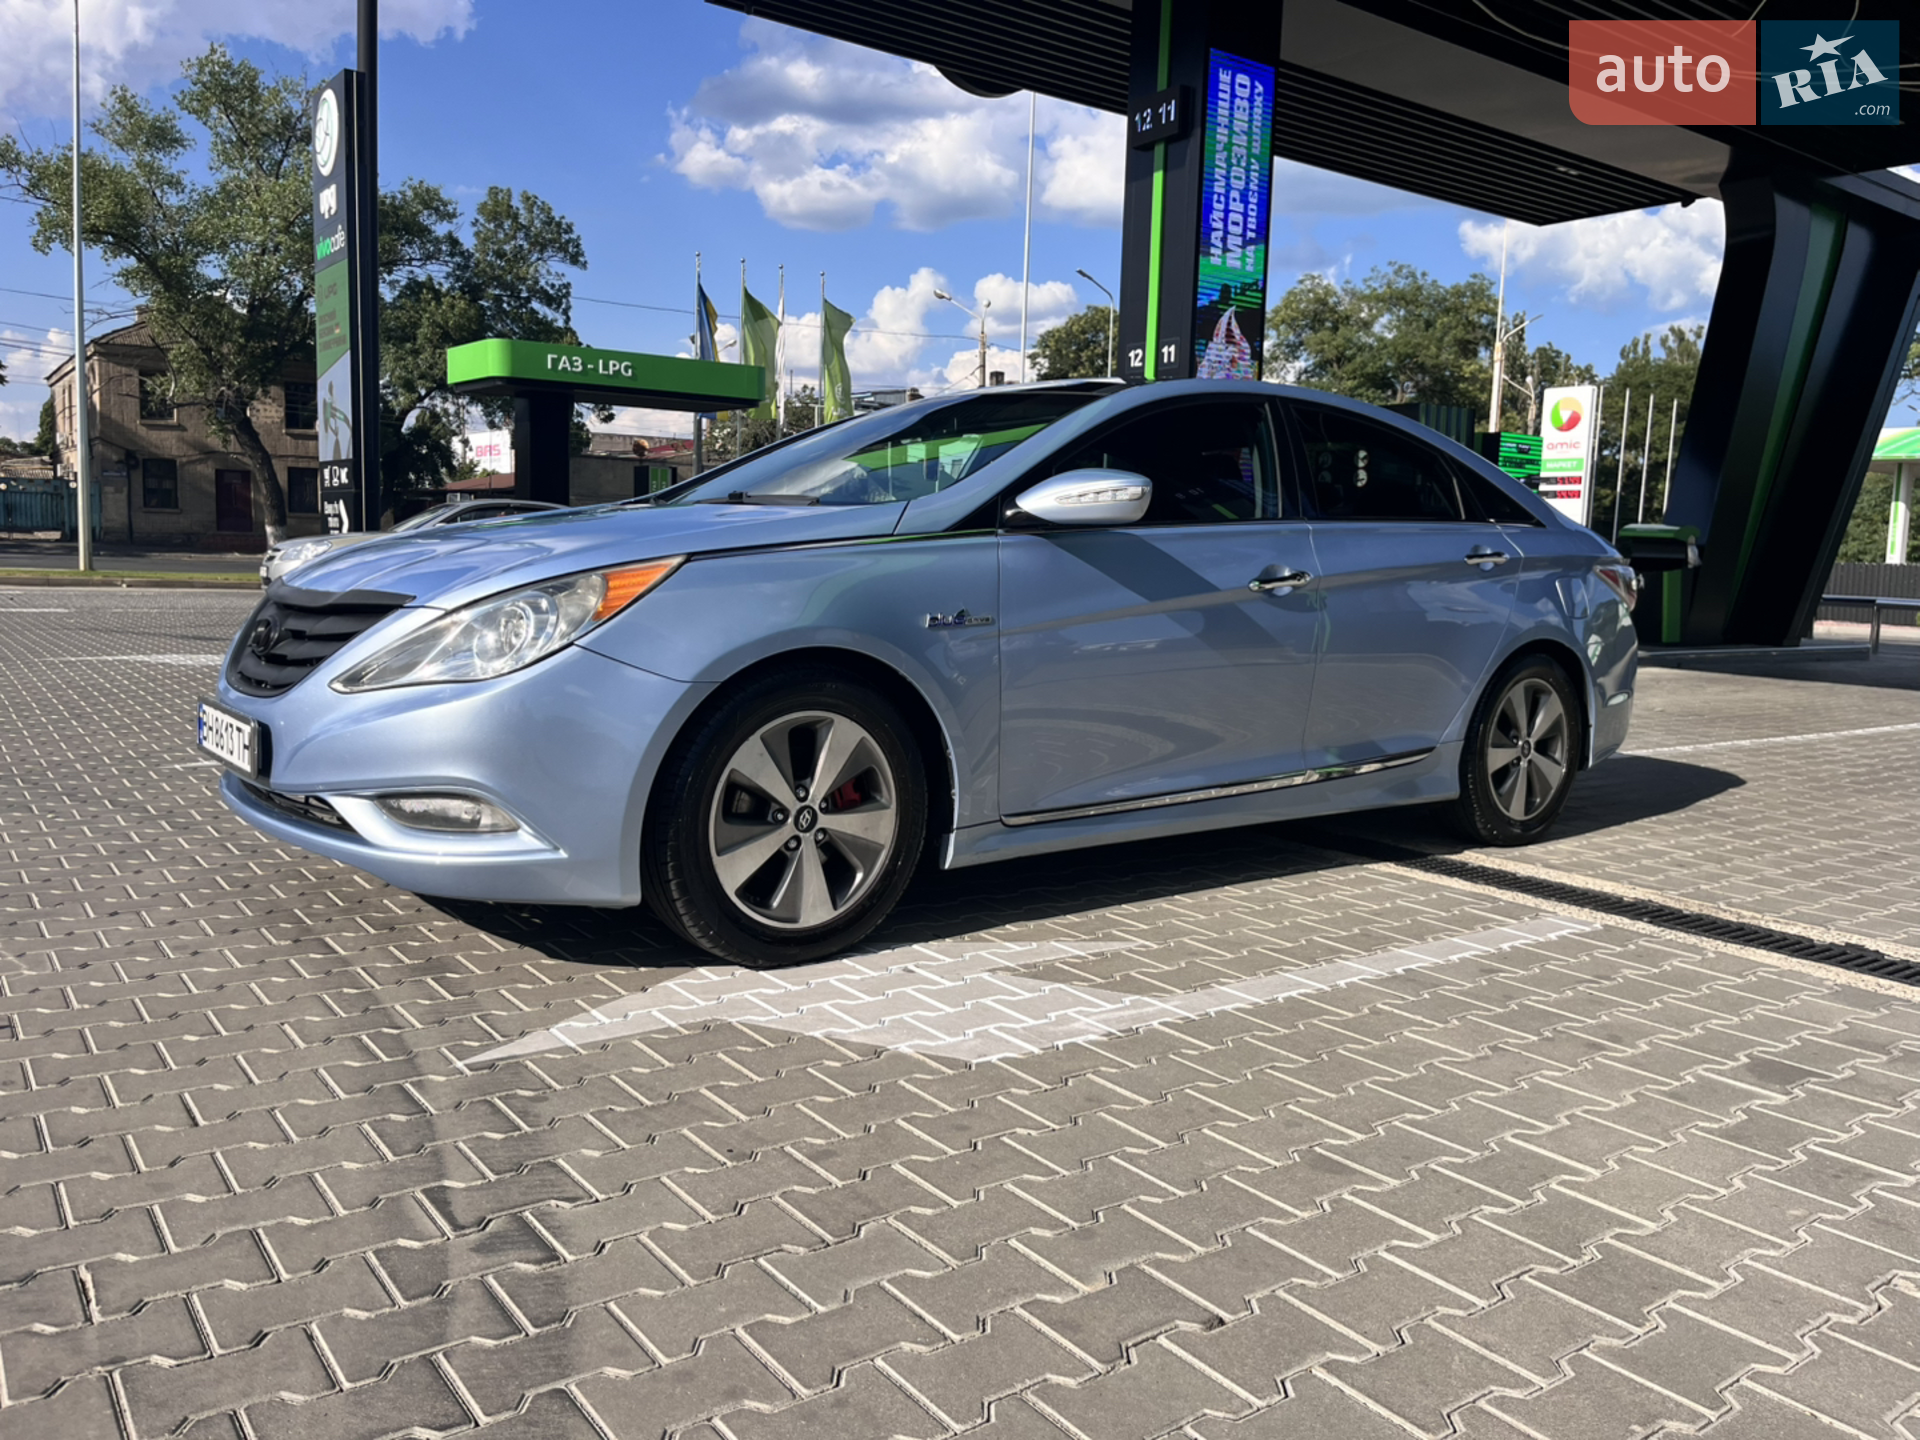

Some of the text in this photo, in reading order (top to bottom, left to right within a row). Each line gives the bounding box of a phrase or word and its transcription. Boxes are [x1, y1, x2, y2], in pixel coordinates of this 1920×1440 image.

[1135, 99, 1176, 132] 12 11
[1210, 68, 1232, 265] НАЙСМАЧНІШЕ
[1226, 74, 1251, 269] МОРОЗИВО
[1245, 80, 1264, 272] НА ТВОЄМУ ШЛЯХУ
[319, 184, 337, 219] upg
[547, 354, 583, 372] ГАЗ
[599, 359, 633, 377] LPG
[1128, 344, 1175, 367] 12 11
[1546, 440, 1581, 451] amic
